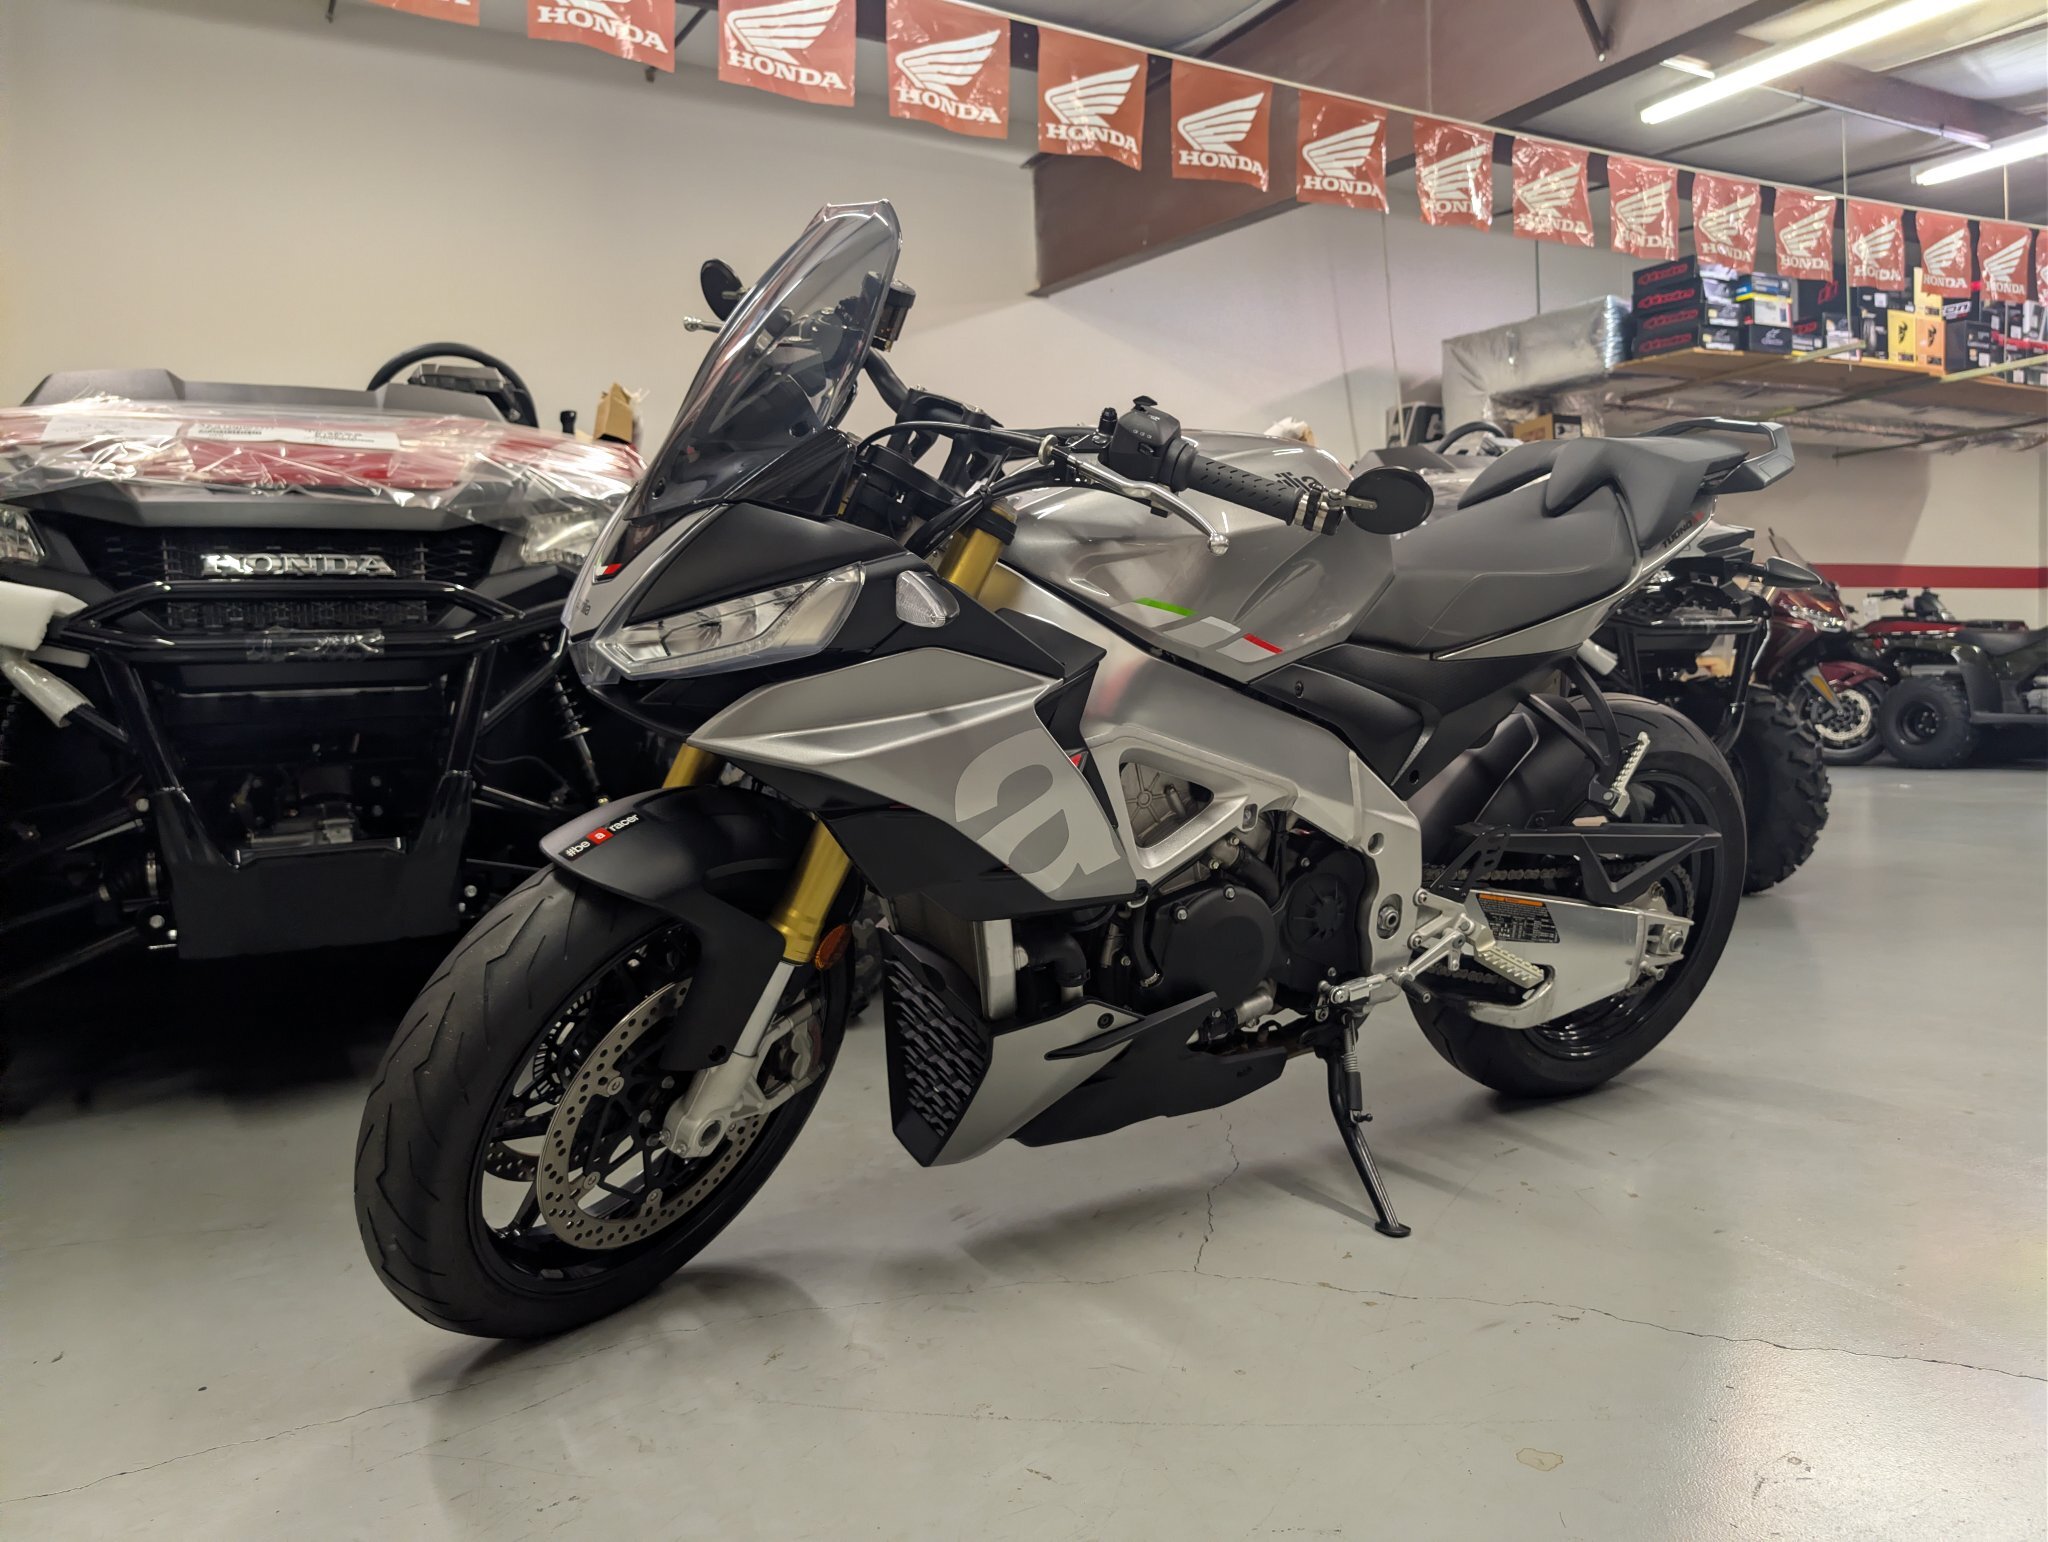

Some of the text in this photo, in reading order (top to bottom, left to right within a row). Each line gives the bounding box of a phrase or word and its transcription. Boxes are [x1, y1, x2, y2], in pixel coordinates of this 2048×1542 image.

[537, 6, 669, 53] HONDA
[728, 49, 847, 90] HONDA
[900, 87, 1002, 124] HONDA
[1046, 123, 1139, 155] HONDA
[1179, 150, 1264, 177] HONDA
[1303, 175, 1383, 197] HONDA
[1780, 255, 1830, 271] HONDA
[1924, 275, 1968, 288] HONDA
[200, 553, 398, 577] HONDA
[565, 840, 591, 857] #be
[609, 813, 639, 832] racer
